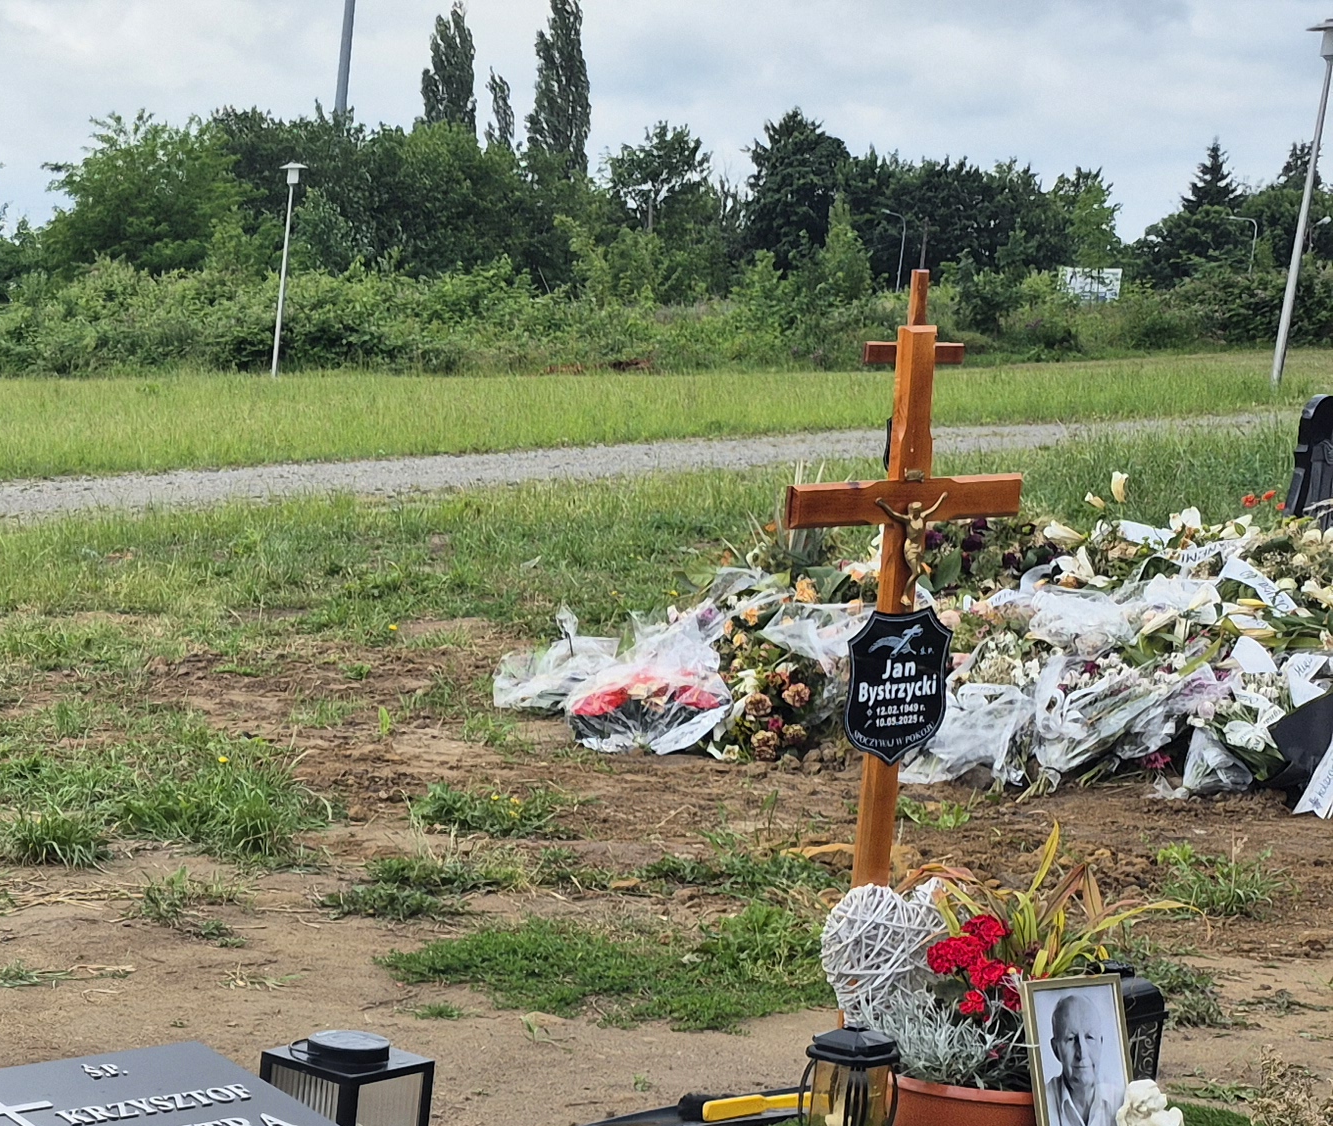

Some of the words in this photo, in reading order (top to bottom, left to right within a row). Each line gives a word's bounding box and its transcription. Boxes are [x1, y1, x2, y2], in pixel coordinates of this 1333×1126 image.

[882, 659, 916, 679] Jan
[858, 674, 937, 707] Bystrzycki
[876, 703, 919, 716] 12.02.1949
[55, 1083, 252, 1126] KRZYSZTOF
